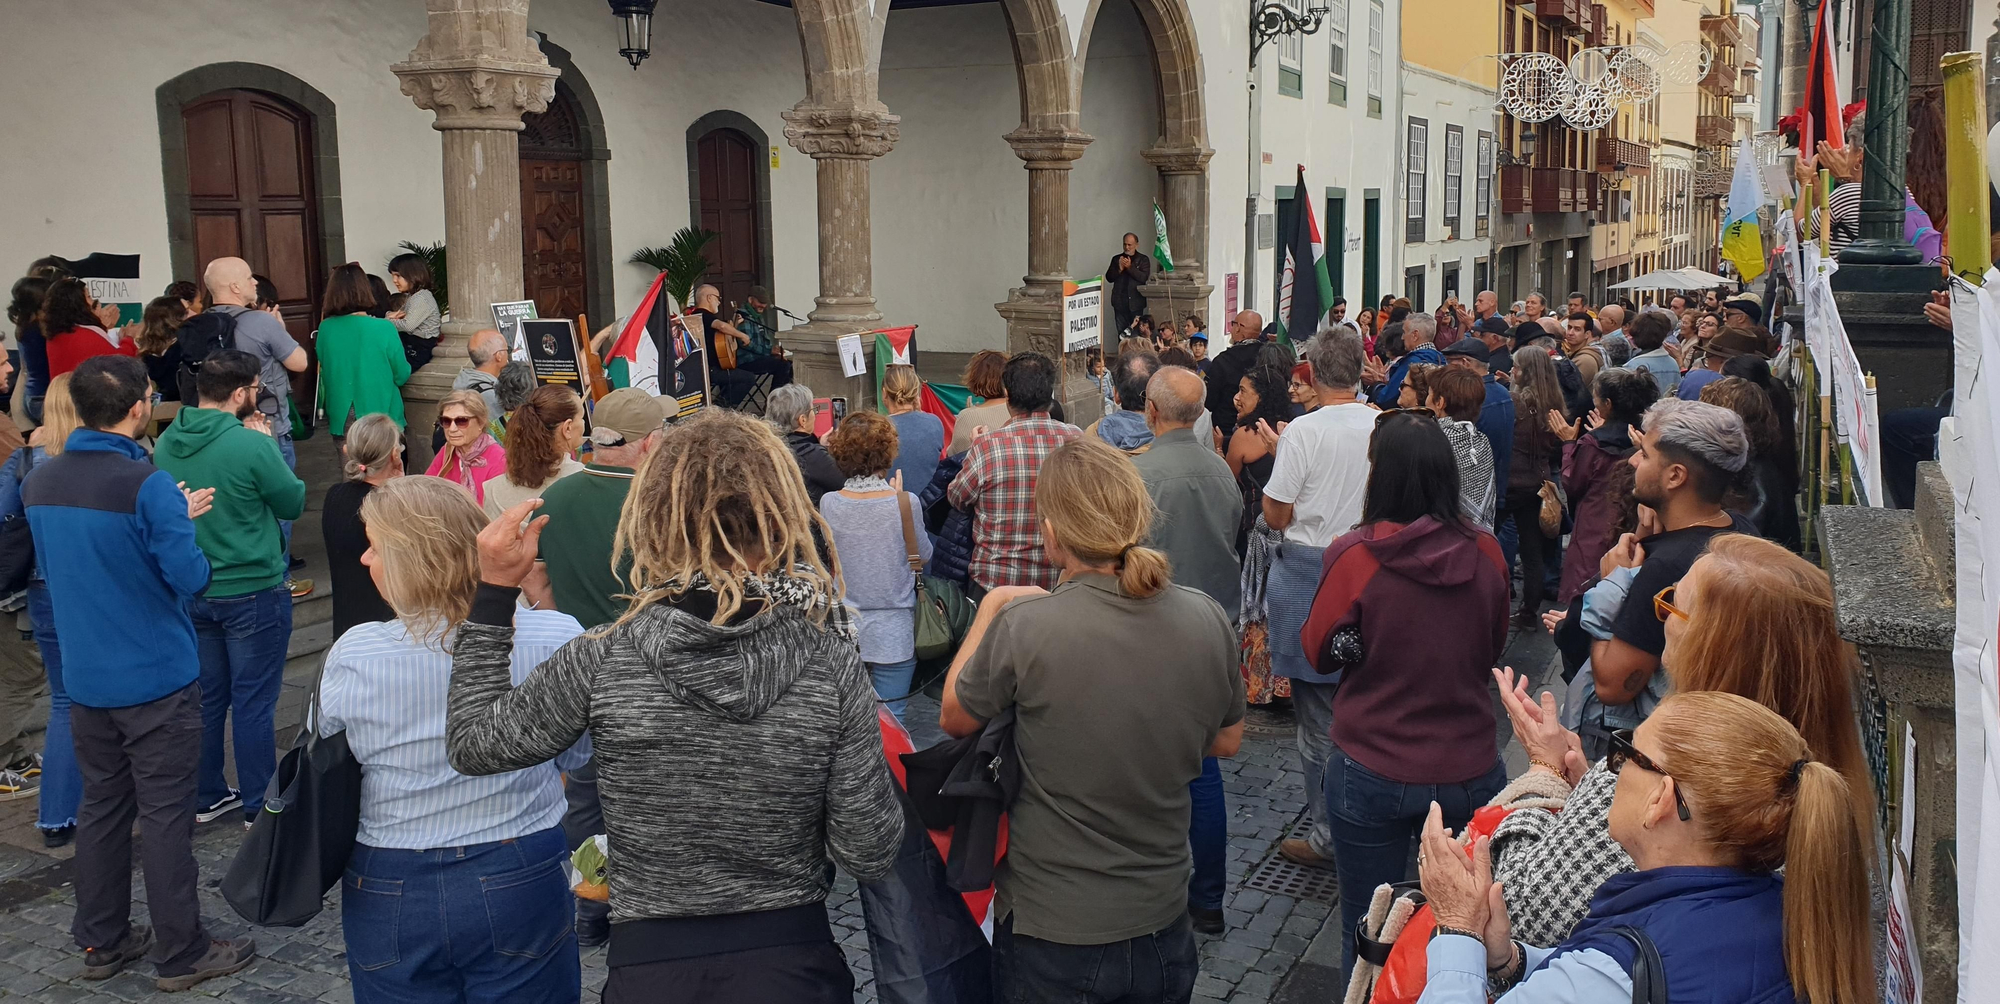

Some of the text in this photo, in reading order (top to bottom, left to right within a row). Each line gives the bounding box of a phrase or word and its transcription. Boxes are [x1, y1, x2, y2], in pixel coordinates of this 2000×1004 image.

[1068, 295, 1099, 310] POR UN ESTADO
[507, 308, 531, 316] GUERRA
[1070, 315, 1098, 334] PALESTINO
